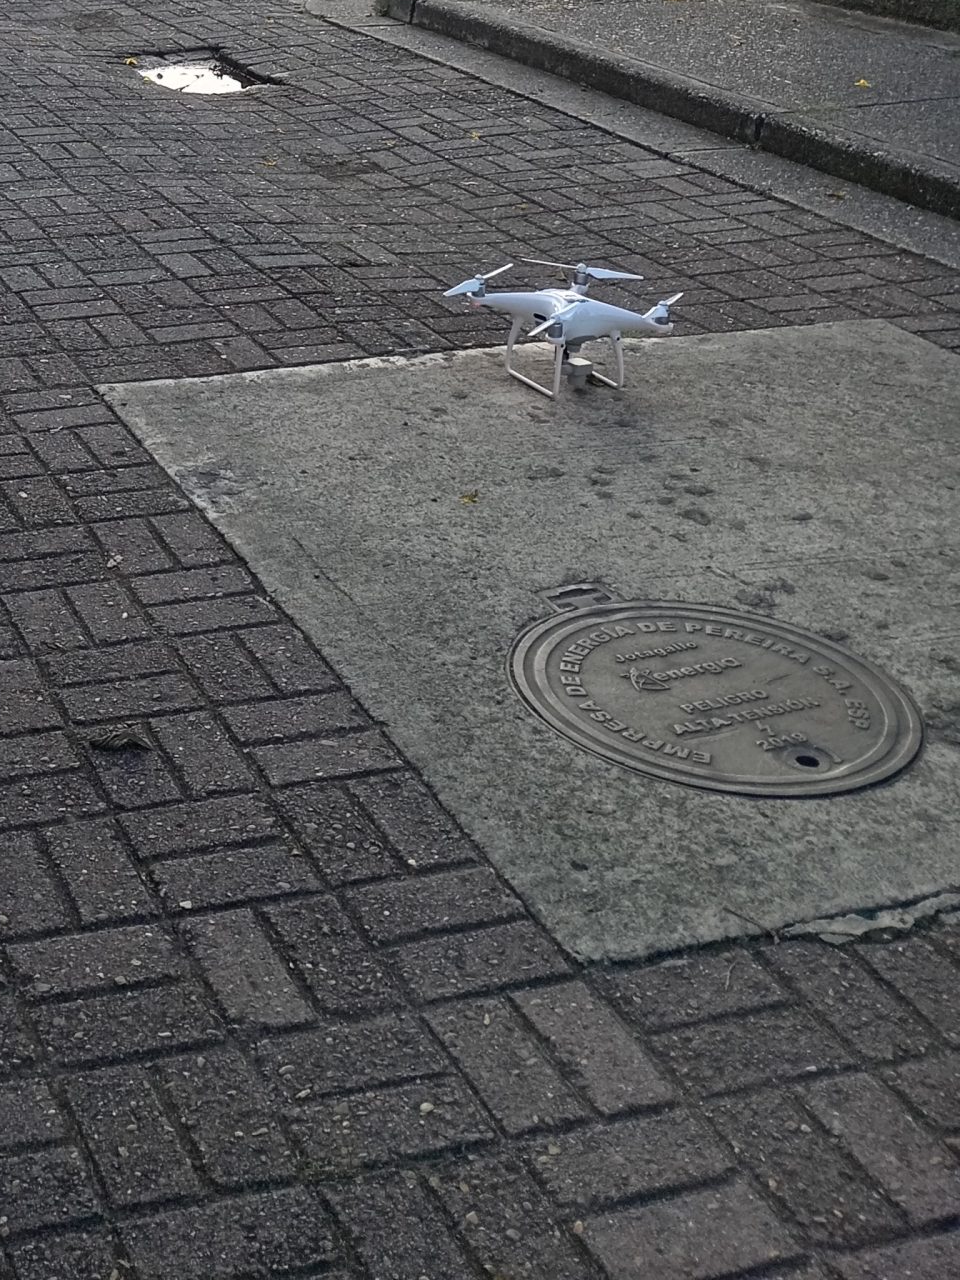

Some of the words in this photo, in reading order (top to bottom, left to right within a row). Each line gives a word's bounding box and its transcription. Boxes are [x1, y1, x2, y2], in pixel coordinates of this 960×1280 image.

[637, 621, 678, 634] DE
[684, 622, 812, 665] PEREIRA
[560, 625, 636, 674] ENERGÍA
[615, 640, 699, 663] Jotagallo
[560, 674, 589, 697] DE
[679, 687, 770, 715] PELIGRO
[673, 717, 732, 736] ALTA
[727, 695, 822, 724] TENSIÓN
[844, 697, 872, 730] ESP
[579, 699, 713, 764] EMPRESA
